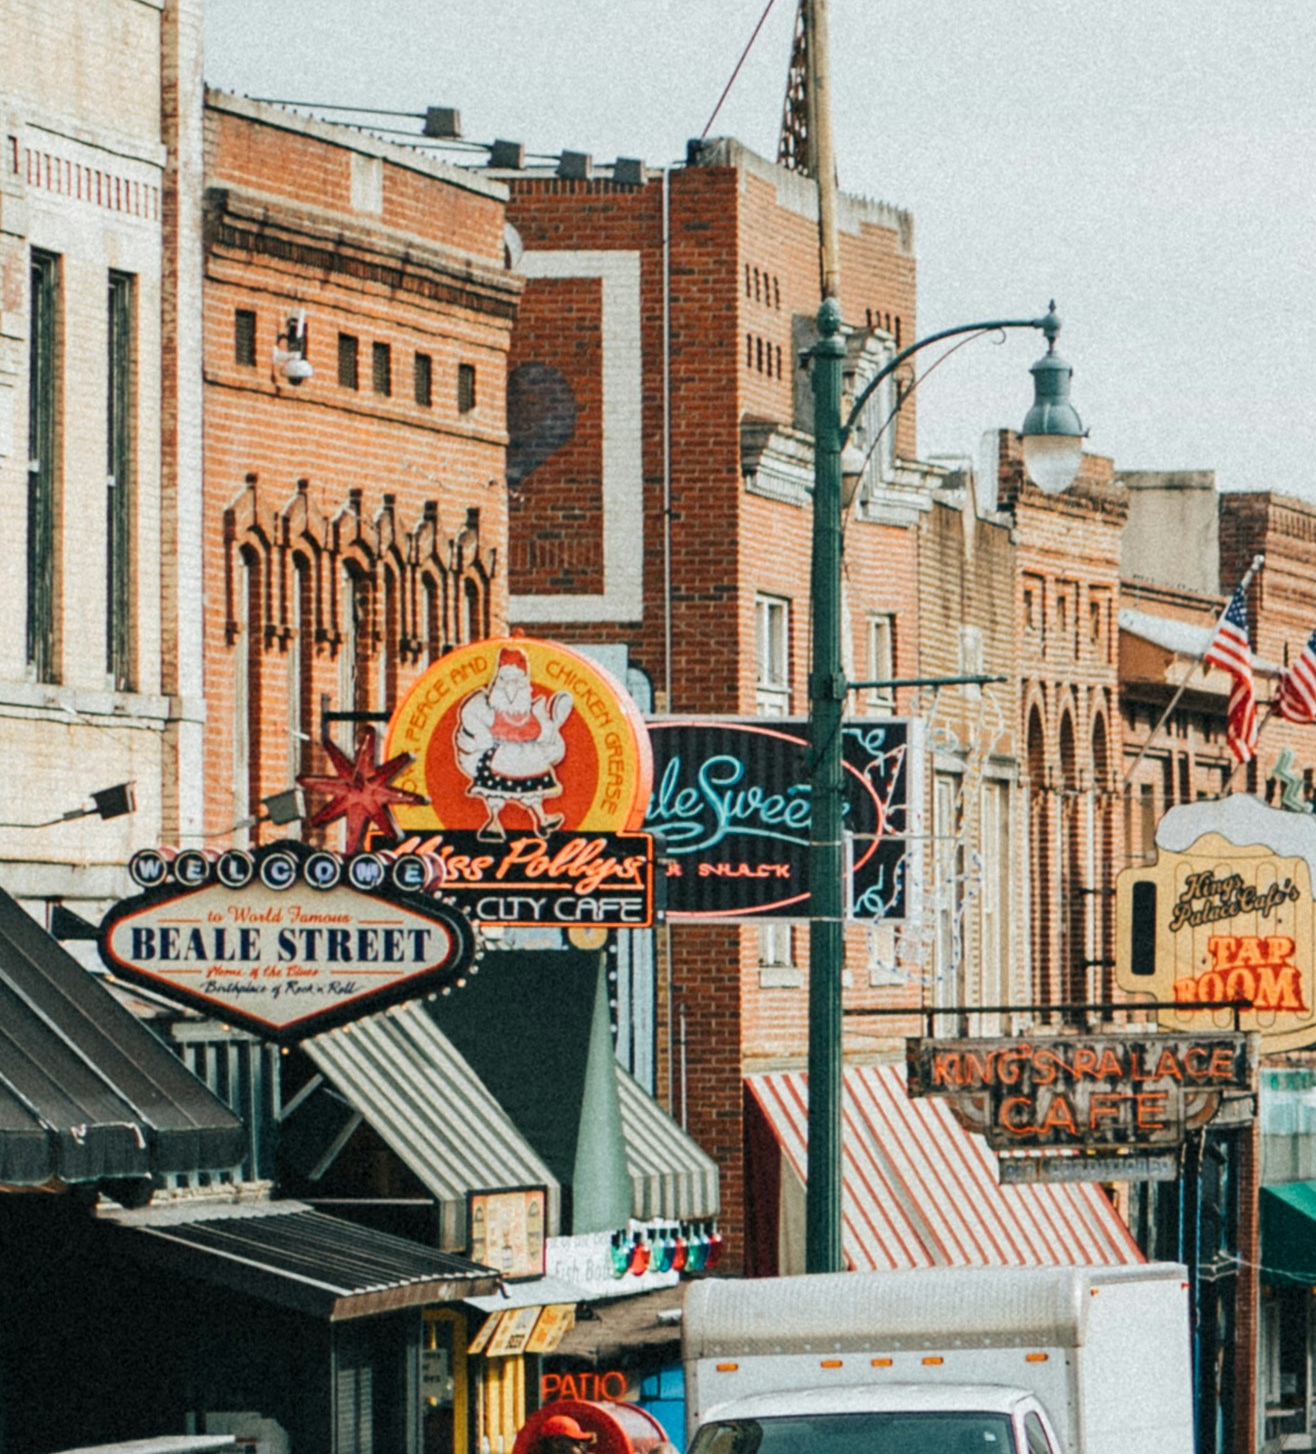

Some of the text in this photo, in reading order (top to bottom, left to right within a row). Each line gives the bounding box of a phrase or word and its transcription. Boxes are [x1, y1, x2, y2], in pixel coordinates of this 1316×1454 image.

[405, 655, 625, 815] PEACE AND CHICKEN GREASE
[138, 855, 425, 887] WELCOME
[697, 863, 791, 878] SHACK
[207, 906, 351, 924] to World Famous
[476, 897, 546, 921] CITY
[554, 897, 643, 922] CAFE
[1169, 897, 1242, 933] Palace
[131, 927, 432, 963] BEALE STREET
[1207, 935, 1297, 971] TAP
[1173, 966, 1308, 1013] ROOM
[934, 1044, 1058, 1086] KING'S
[1001, 1092, 1165, 1135] CAFE
[541, 1371, 628, 1403] PATIO
